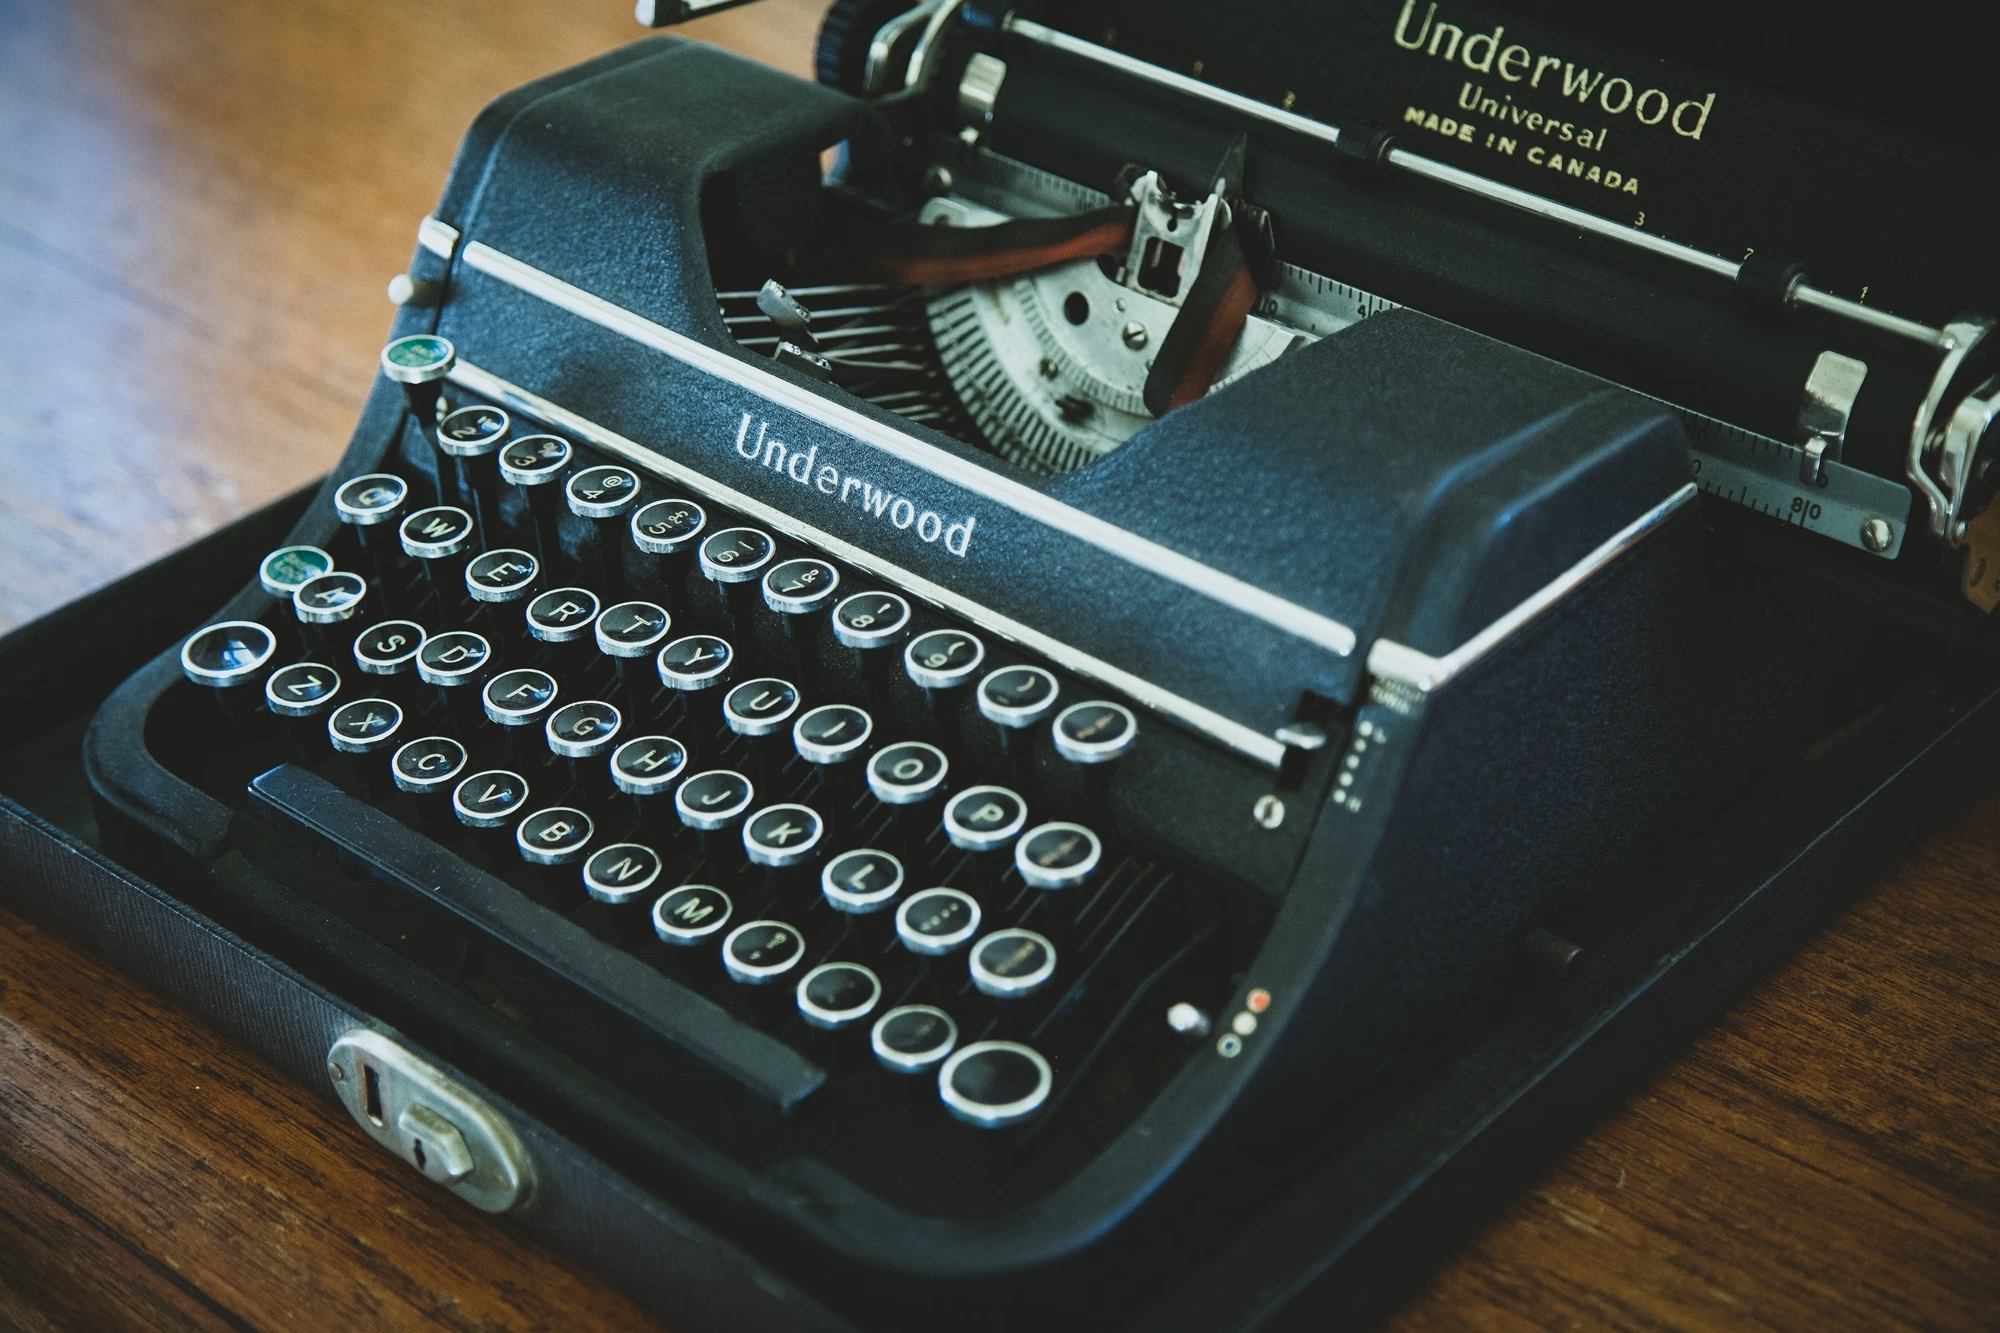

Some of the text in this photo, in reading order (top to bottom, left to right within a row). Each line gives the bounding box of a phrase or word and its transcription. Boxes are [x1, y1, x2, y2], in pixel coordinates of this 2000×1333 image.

[1394, 0, 1716, 140] Underwood
[1457, 82, 1608, 151] Universal
[1404, 106, 1639, 195] MADE IN CANADA
[1634, 211, 1646, 226] 3
[451, 426, 477, 439] 2
[514, 455, 537, 467] 3
[582, 489, 605, 500] 4
[736, 413, 976, 558] Underwood
[422, 517, 456, 538] W
[648, 521, 672, 535] 5
[716, 549, 740, 563] 6
[487, 562, 519, 581] E
[782, 580, 805, 593] 7
[549, 601, 580, 622] R
[850, 613, 875, 628] 8
[622, 615, 652, 634] T
[377, 634, 406, 653] S
[439, 645, 469, 664] D
[684, 647, 715, 666] Y
[924, 653, 948, 668] 9
[287, 674, 322, 696] Z
[505, 683, 537, 699] F
[750, 691, 782, 711] U
[349, 712, 385, 732] X
[572, 716, 600, 736] G
[418, 753, 446, 771] C
[633, 750, 669, 772] H
[893, 758, 924, 779] O
[478, 784, 511, 803] V
[701, 790, 732, 805] J
[970, 803, 1005, 822] P
[538, 821, 571, 842] B
[767, 821, 803, 845] K
[607, 857, 643, 881] N
[850, 863, 875, 890] L
[674, 897, 714, 924] M
